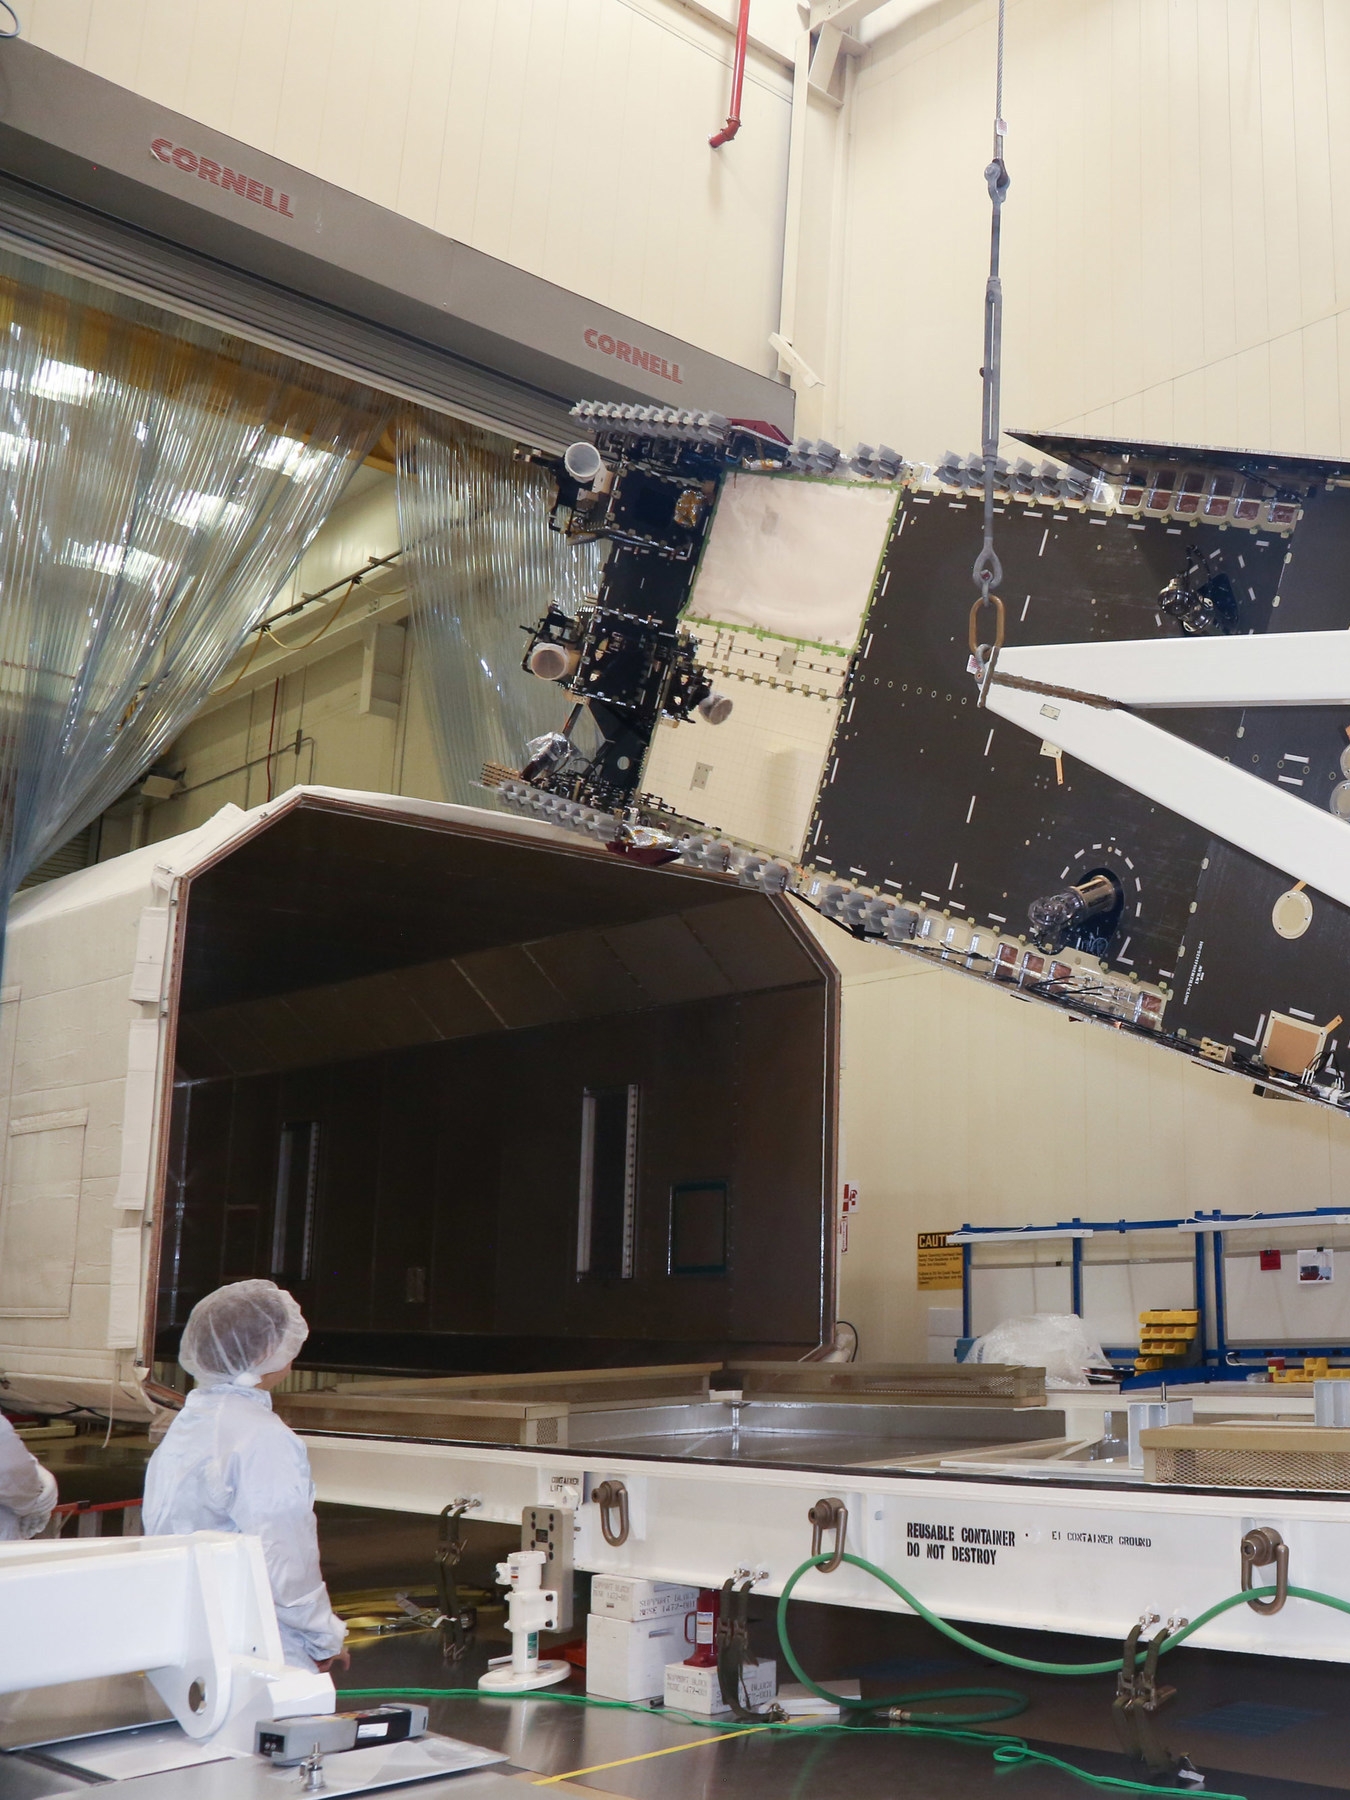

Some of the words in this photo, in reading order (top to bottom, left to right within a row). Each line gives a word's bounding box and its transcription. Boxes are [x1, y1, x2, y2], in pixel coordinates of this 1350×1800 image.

[151, 138, 295, 219] CORNELL
[583, 328, 683, 385] CORNELL
[919, 1233, 963, 1248] CAUT
[550, 1484, 563, 1492] LIFT
[906, 1522, 955, 1542] REUSABLE
[961, 1527, 1016, 1547] CONTAINER
[1067, 1532, 1114, 1545] CONTAINER
[1118, 1535, 1152, 1548] GROUND
[906, 1541, 920, 1558] DO
[926, 1543, 945, 1560] NOT
[952, 1545, 997, 1566] DESTROY
